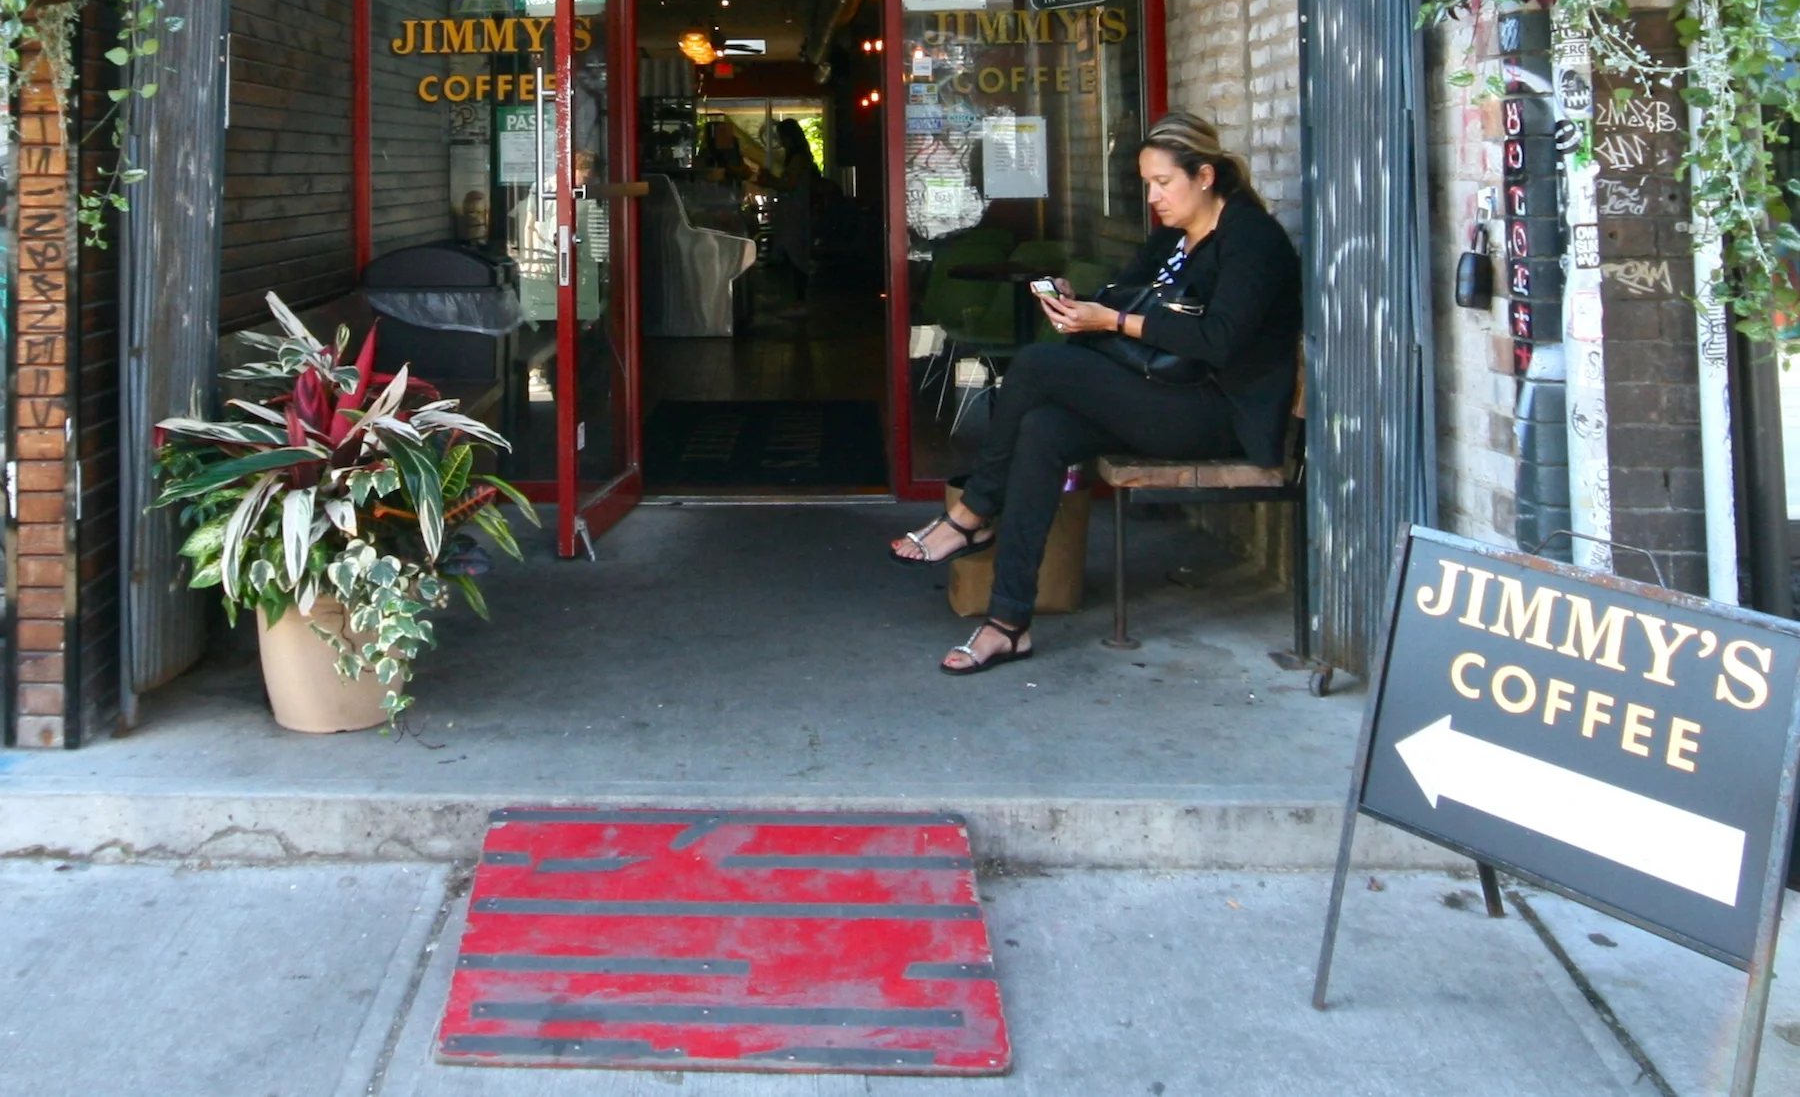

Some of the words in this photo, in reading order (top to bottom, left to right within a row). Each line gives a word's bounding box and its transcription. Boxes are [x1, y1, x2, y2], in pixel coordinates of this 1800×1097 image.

[392, 16, 594, 55] JIMMYS
[953, 65, 1097, 94] COFFEE
[1416, 559, 1772, 710] JIMMY'S
[1450, 652, 1701, 773] COFFEE
